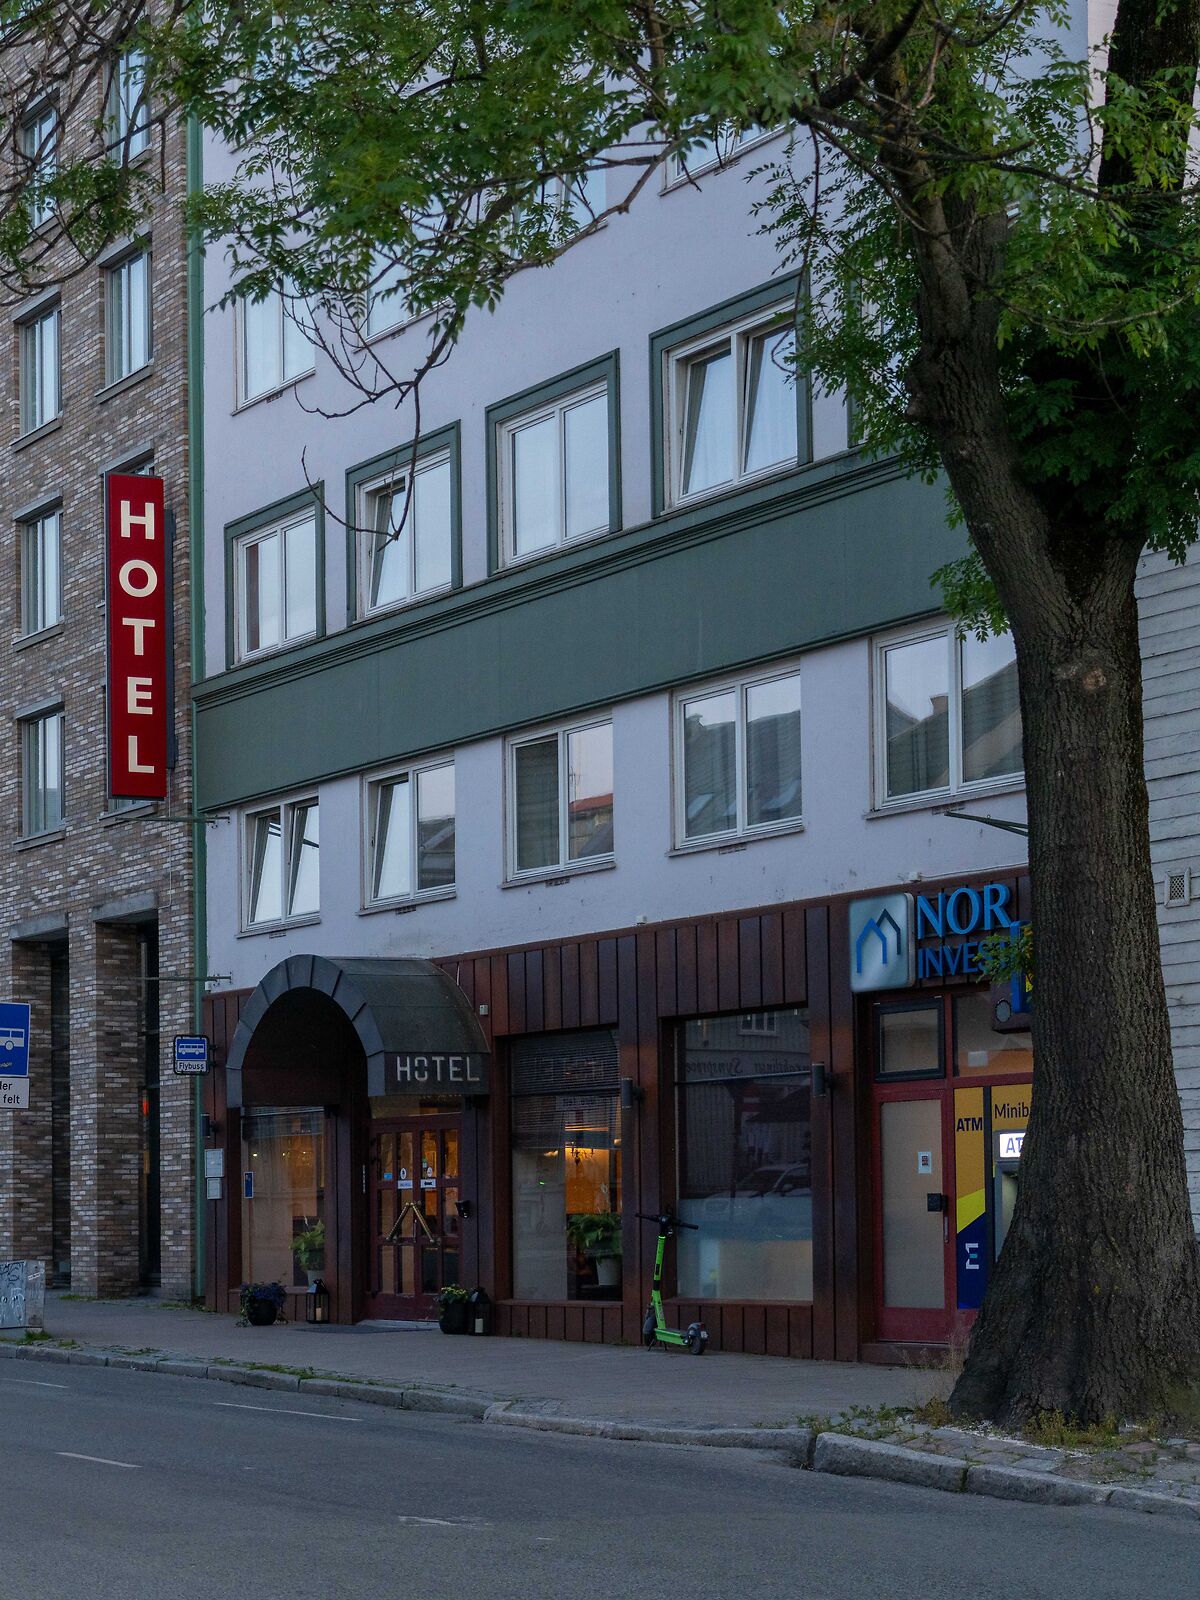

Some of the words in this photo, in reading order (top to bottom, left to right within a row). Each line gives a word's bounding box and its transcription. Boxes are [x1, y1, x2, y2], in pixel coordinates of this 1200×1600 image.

[118, 500, 158, 774] HOTEL
[916, 883, 1012, 940] NOR
[178, 1062, 205, 1071] Flybuss
[396, 1055, 481, 1082] HOTEL
[3, 1094, 20, 1104] felt
[994, 1102, 1029, 1119] Minib
[956, 1117, 983, 1132] ATM
